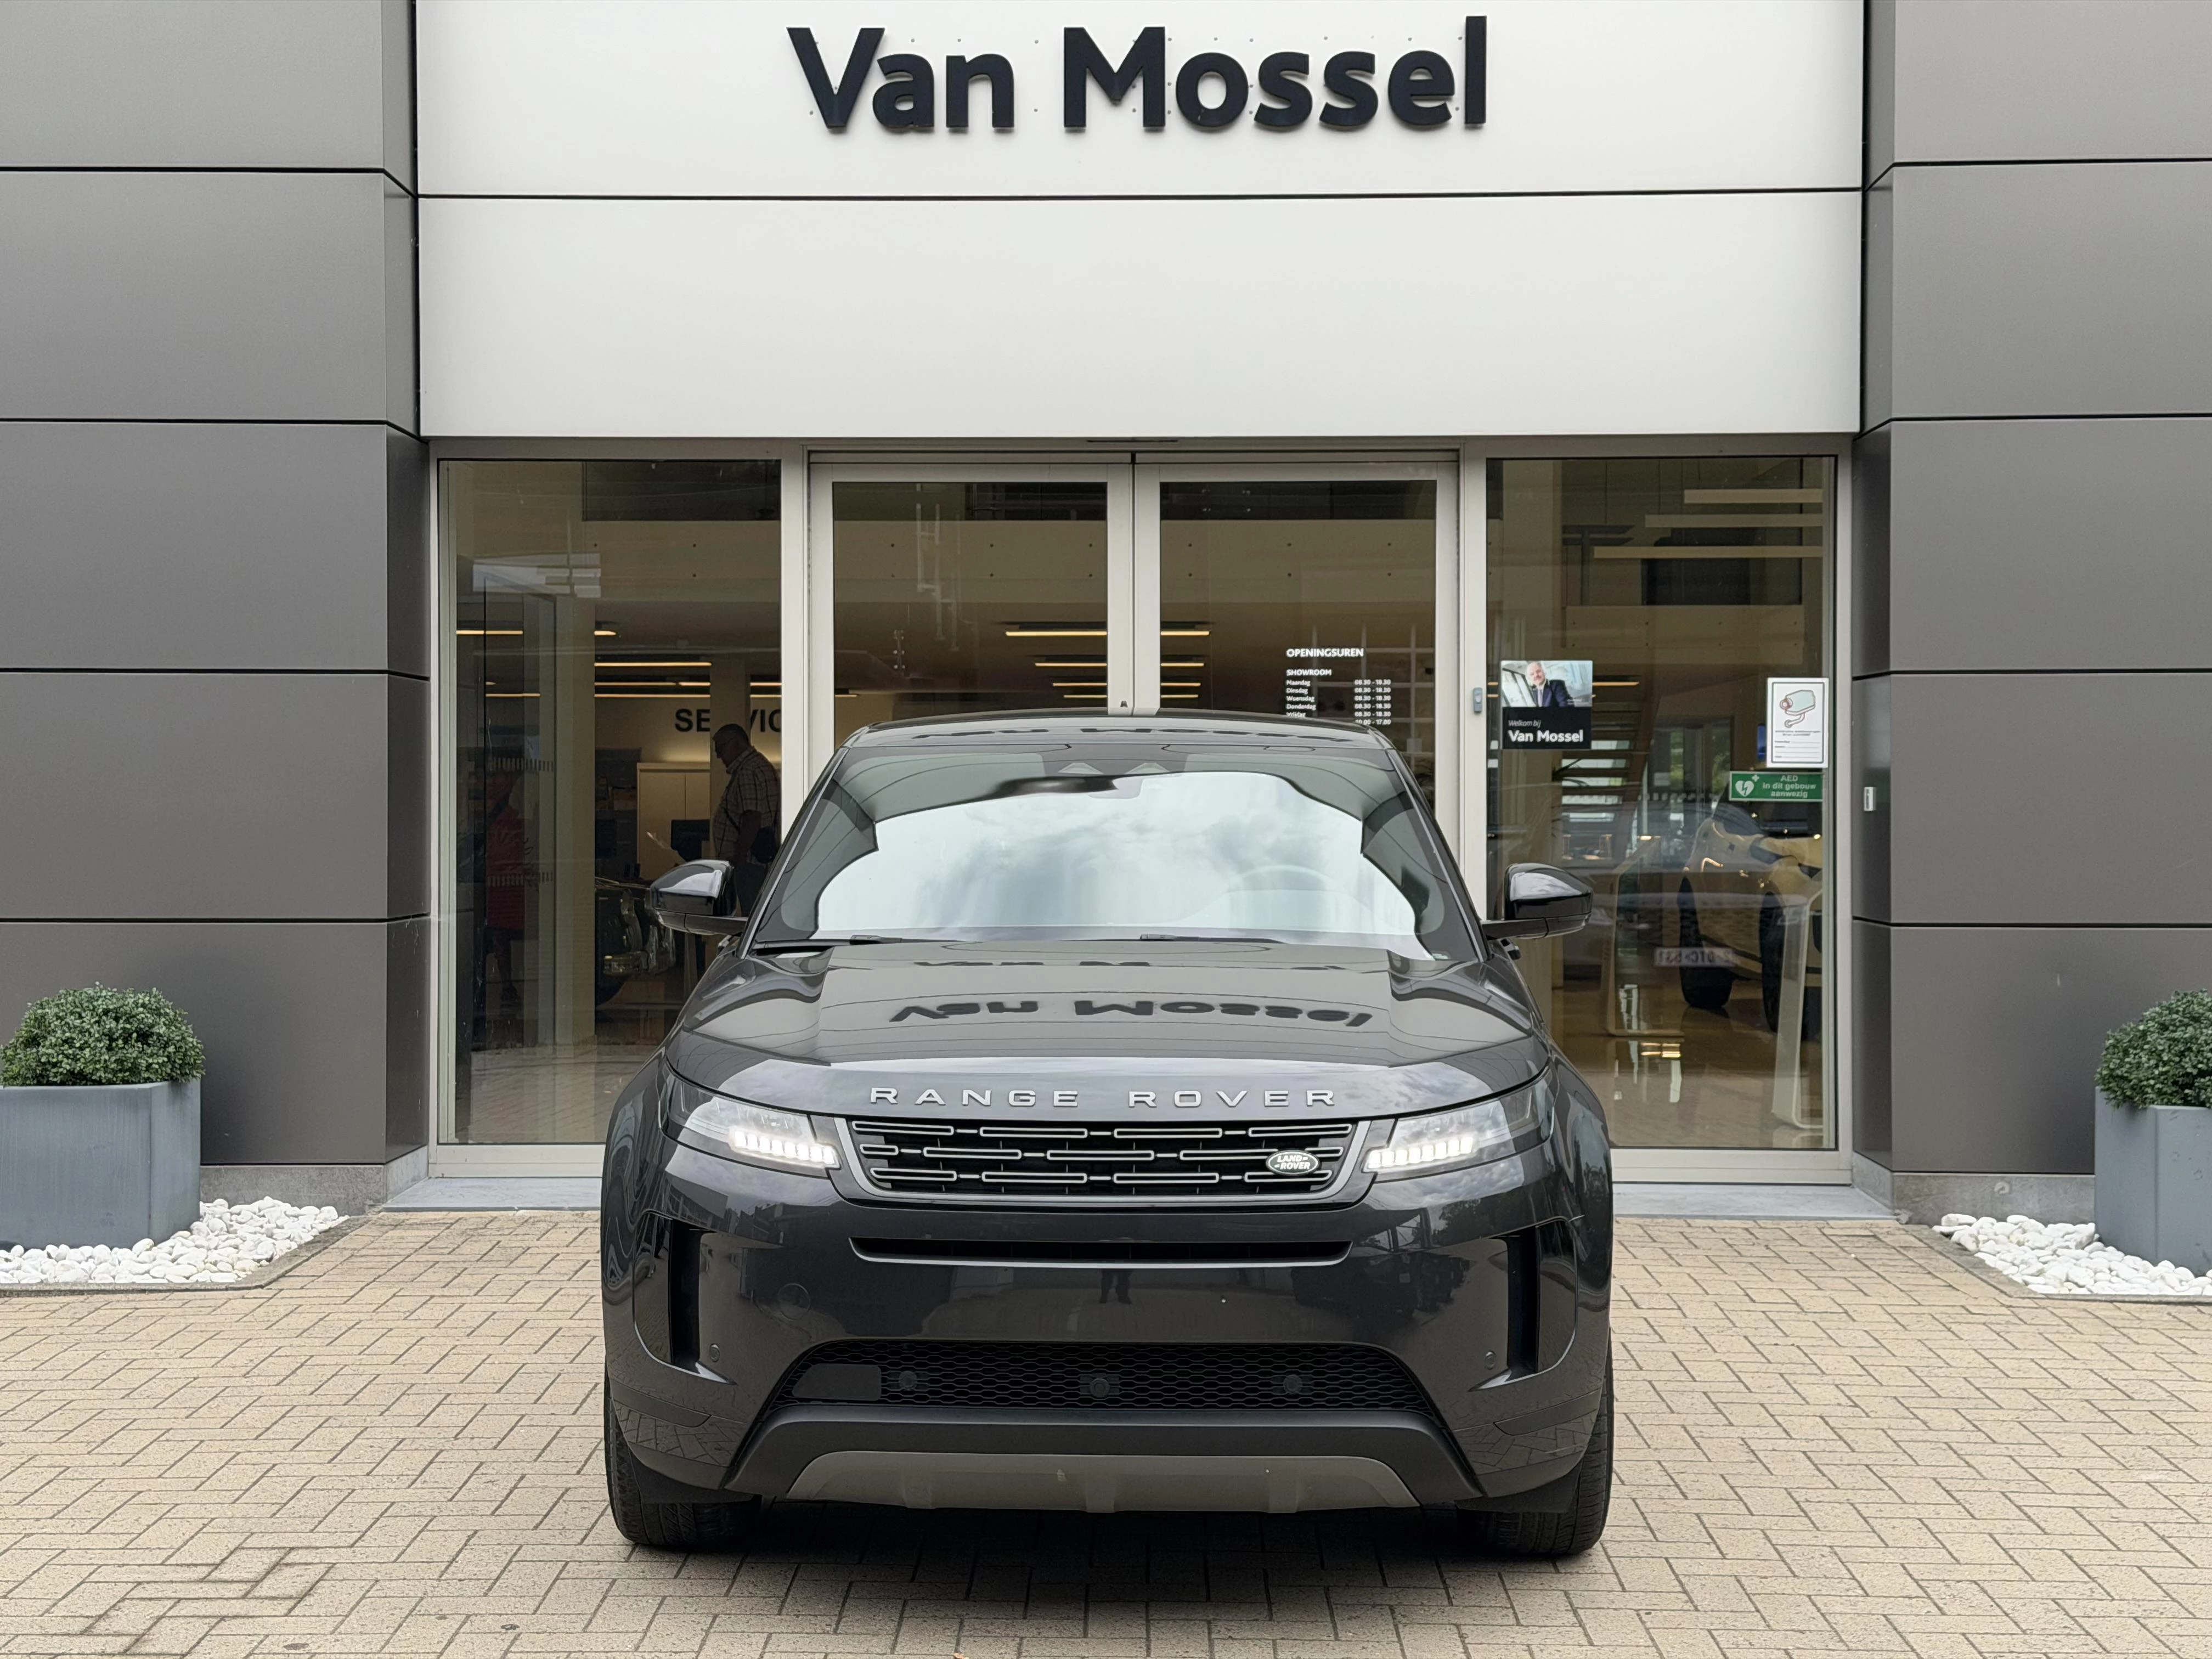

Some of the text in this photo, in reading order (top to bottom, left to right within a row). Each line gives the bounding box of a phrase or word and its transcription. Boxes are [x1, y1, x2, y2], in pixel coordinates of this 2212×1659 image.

[786, 15, 1488, 129] Van Mossel
[1286, 648, 1364, 658] OPENINGSUREN
[1533, 720, 1542, 728] bij
[1508, 729, 1584, 742] Van Mossel
[1785, 782, 1816, 791] gebouw
[1771, 790, 1808, 798] aanwezig
[870, 1087, 1335, 1108] RANGE ROVER
[1280, 1161, 1311, 1170] ROVER
